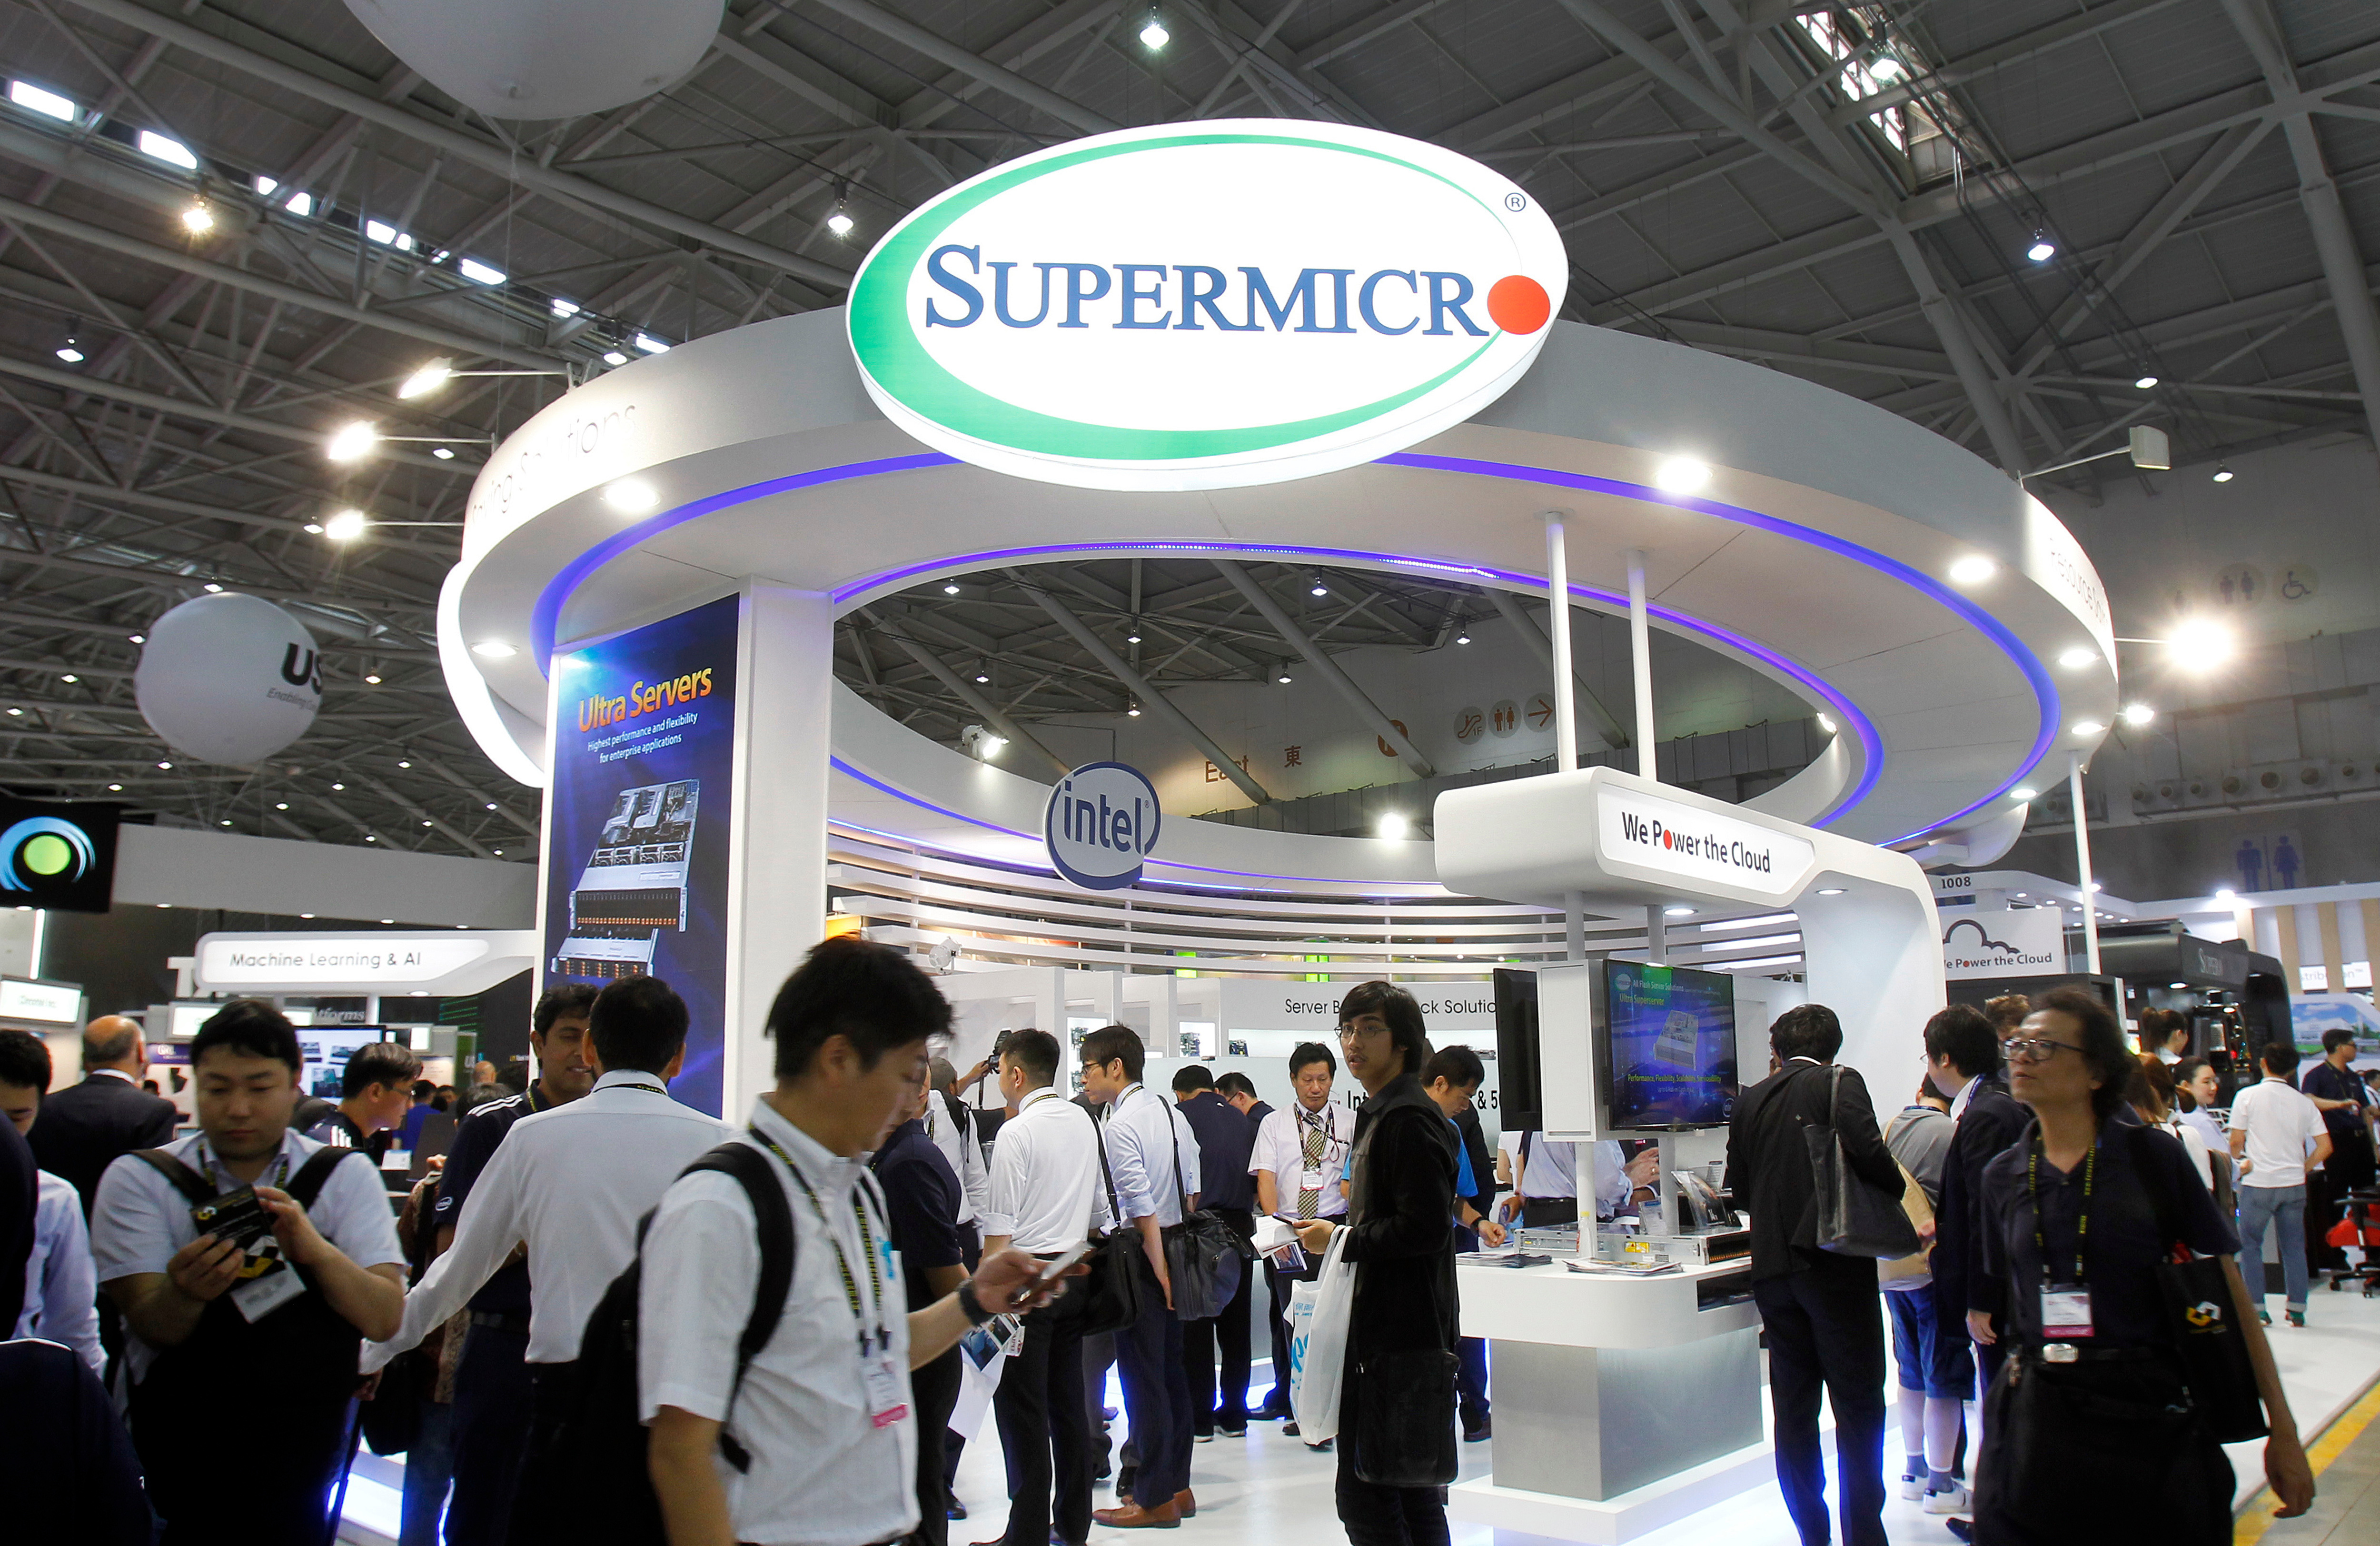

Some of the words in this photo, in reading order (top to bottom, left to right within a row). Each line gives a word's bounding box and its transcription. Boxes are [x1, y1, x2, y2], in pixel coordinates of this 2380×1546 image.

[579, 692, 626, 732] Ultra
[629, 667, 713, 718] Servers
[587, 737, 611, 752] Highest
[612, 727, 651, 748] performance
[653, 720, 665, 734] and
[666, 712, 698, 730] flexibility
[600, 752, 609, 763] for
[609, 745, 641, 760] enterprise
[642, 734, 682, 755] applications
[1284, 745, 1302, 768] 東
[1063, 779, 1141, 855] intel
[1621, 811, 1648, 844] We
[1652, 819, 1701, 857] Power
[1704, 833, 1727, 863] the
[1731, 841, 1771, 874] Cloud
[1941, 876, 1972, 889] 1008
[229, 953, 303, 967] Machine
[309, 953, 380, 969] Learning
[387, 953, 397, 966] &
[404, 953, 421, 966] AI
[1944, 959, 1953, 969] e
[1955, 958, 1992, 968] Power
[1994, 956, 2014, 966] the
[2016, 952, 2053, 964] Cloud
[1285, 998, 1328, 1014] Server
[1444, 999, 1497, 1014] Solutio
[1478, 1090, 1487, 1110] &
[1491, 1090, 1498, 1109] 5
